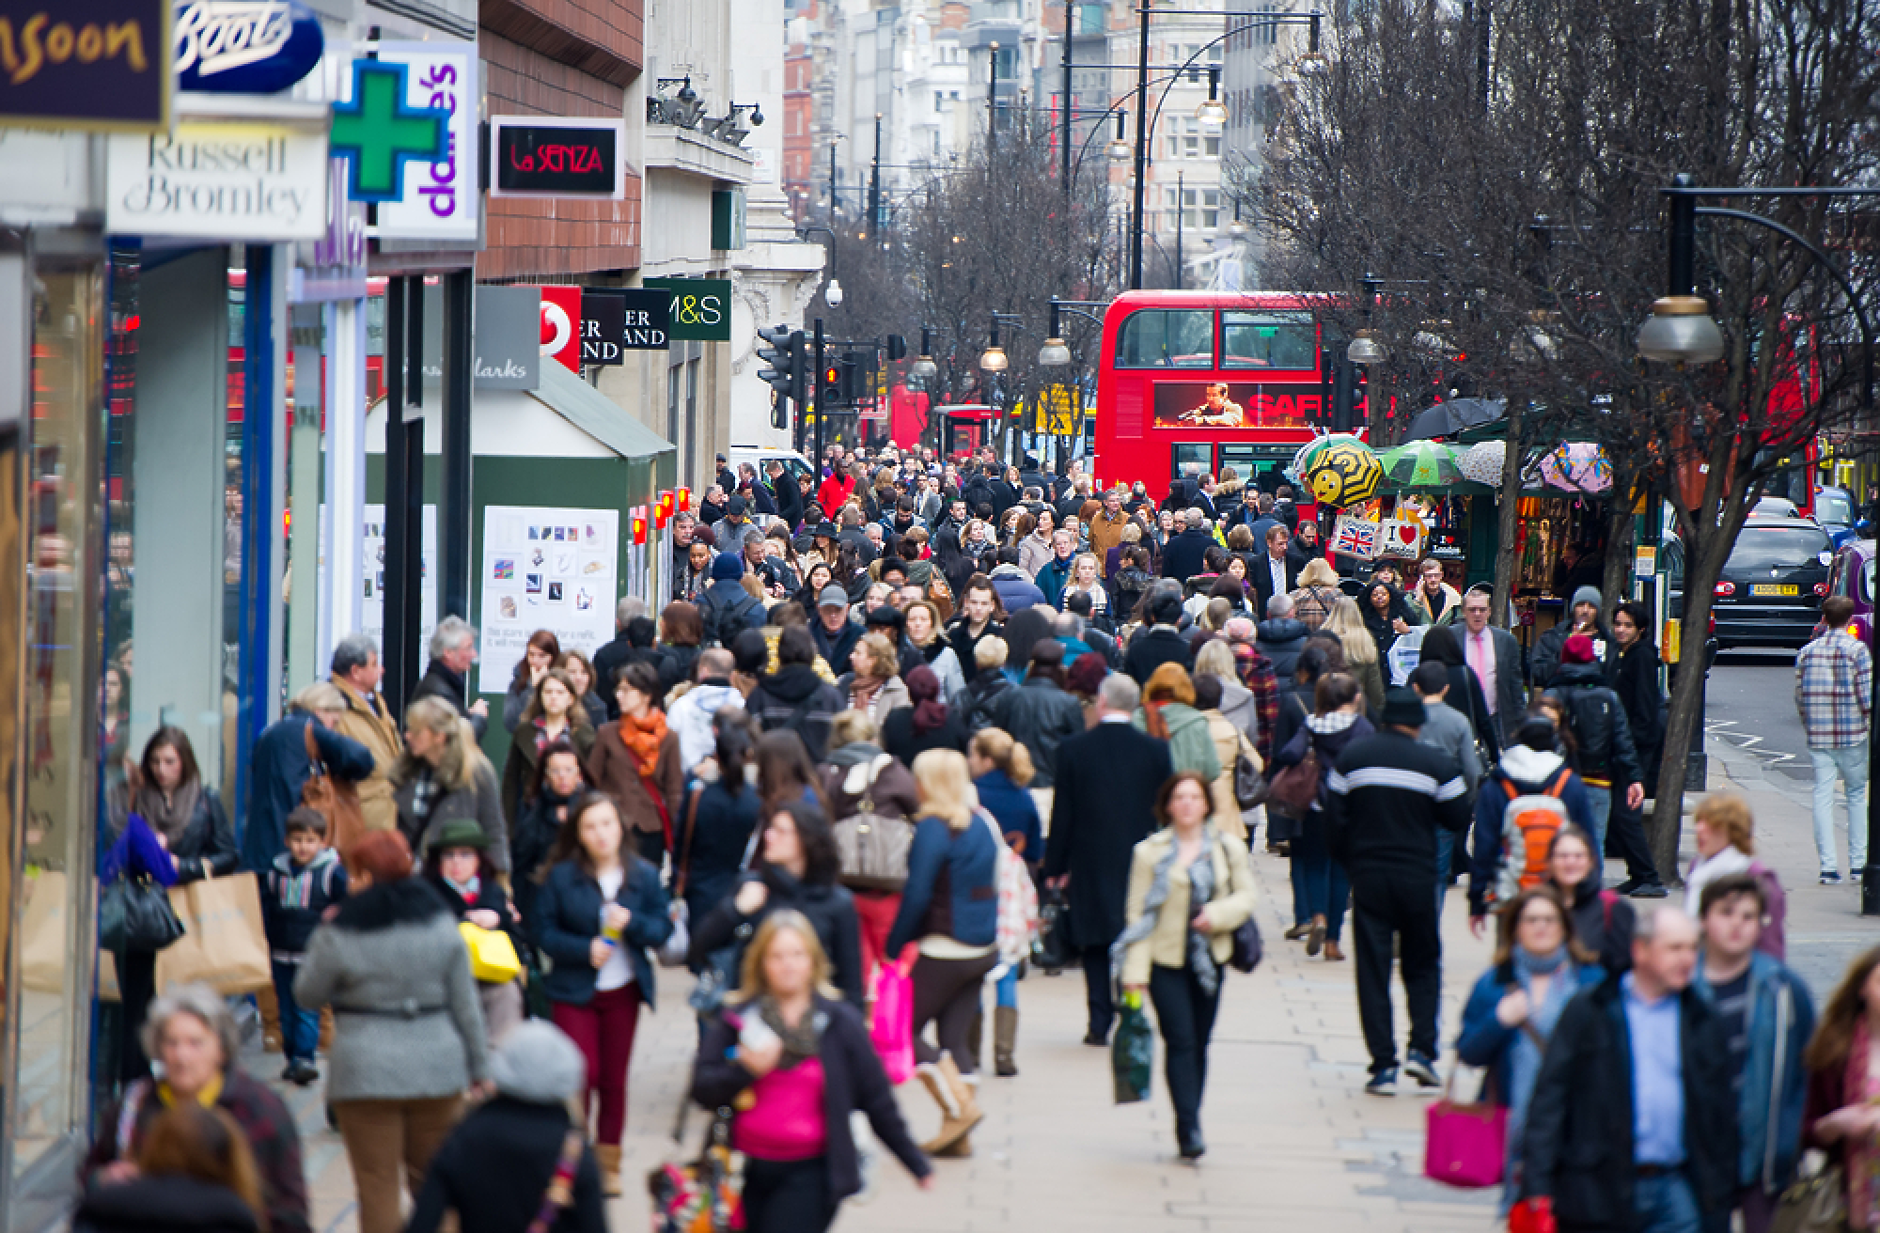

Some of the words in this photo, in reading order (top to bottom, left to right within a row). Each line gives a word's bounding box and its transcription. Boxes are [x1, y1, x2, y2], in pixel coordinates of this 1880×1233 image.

[148, 132, 287, 174] Russell
[510, 144, 535, 172] La
[536, 144, 604, 173] SENZA
[122, 174, 311, 225] Bromley
[579, 341, 619, 360] ND
[472, 356, 527, 379] larks
